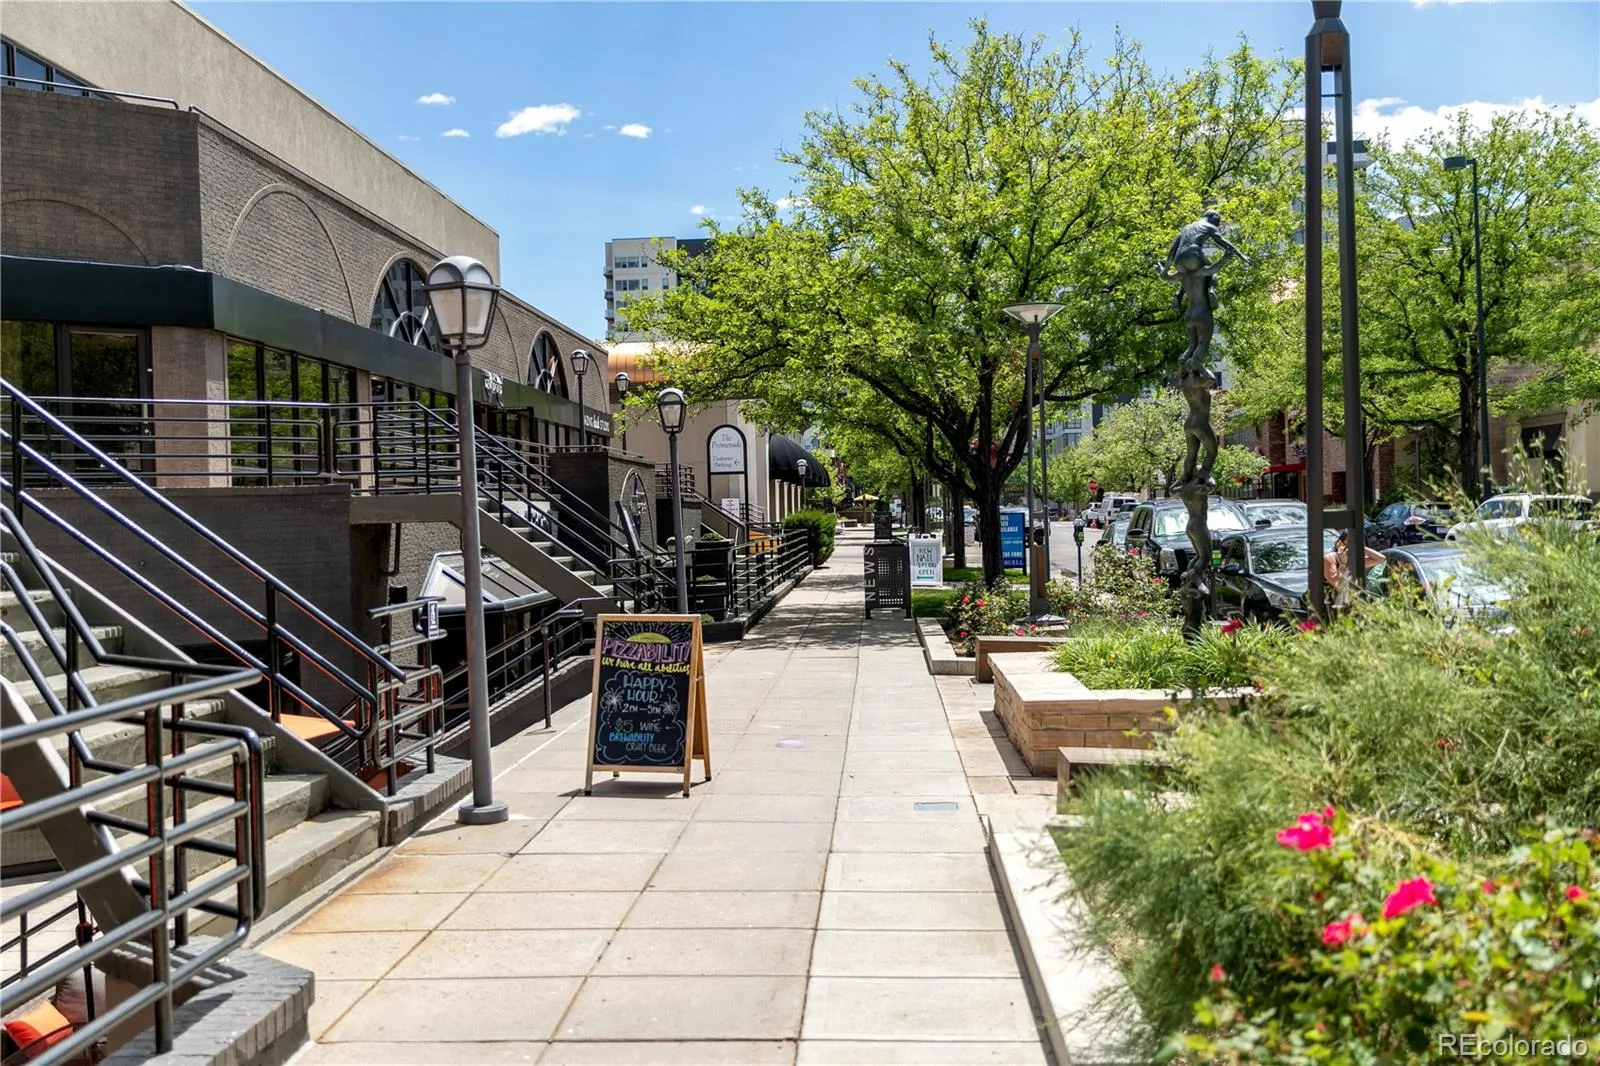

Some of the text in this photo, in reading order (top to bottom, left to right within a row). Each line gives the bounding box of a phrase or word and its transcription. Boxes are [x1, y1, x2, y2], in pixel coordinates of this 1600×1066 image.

[720, 434, 732, 442] The
[711, 440, 742, 449] Promenade
[916, 554, 933, 562] NAIL
[864, 547, 876, 601] NEWS
[637, 662, 653, 672] all
[623, 675, 667, 692] HAPPY
[627, 689, 659, 703] HOUR
[614, 717, 662, 733] $5 WINE
[608, 732, 655, 743] BREWABILITY
[625, 742, 668, 754] CRAFT BEER
